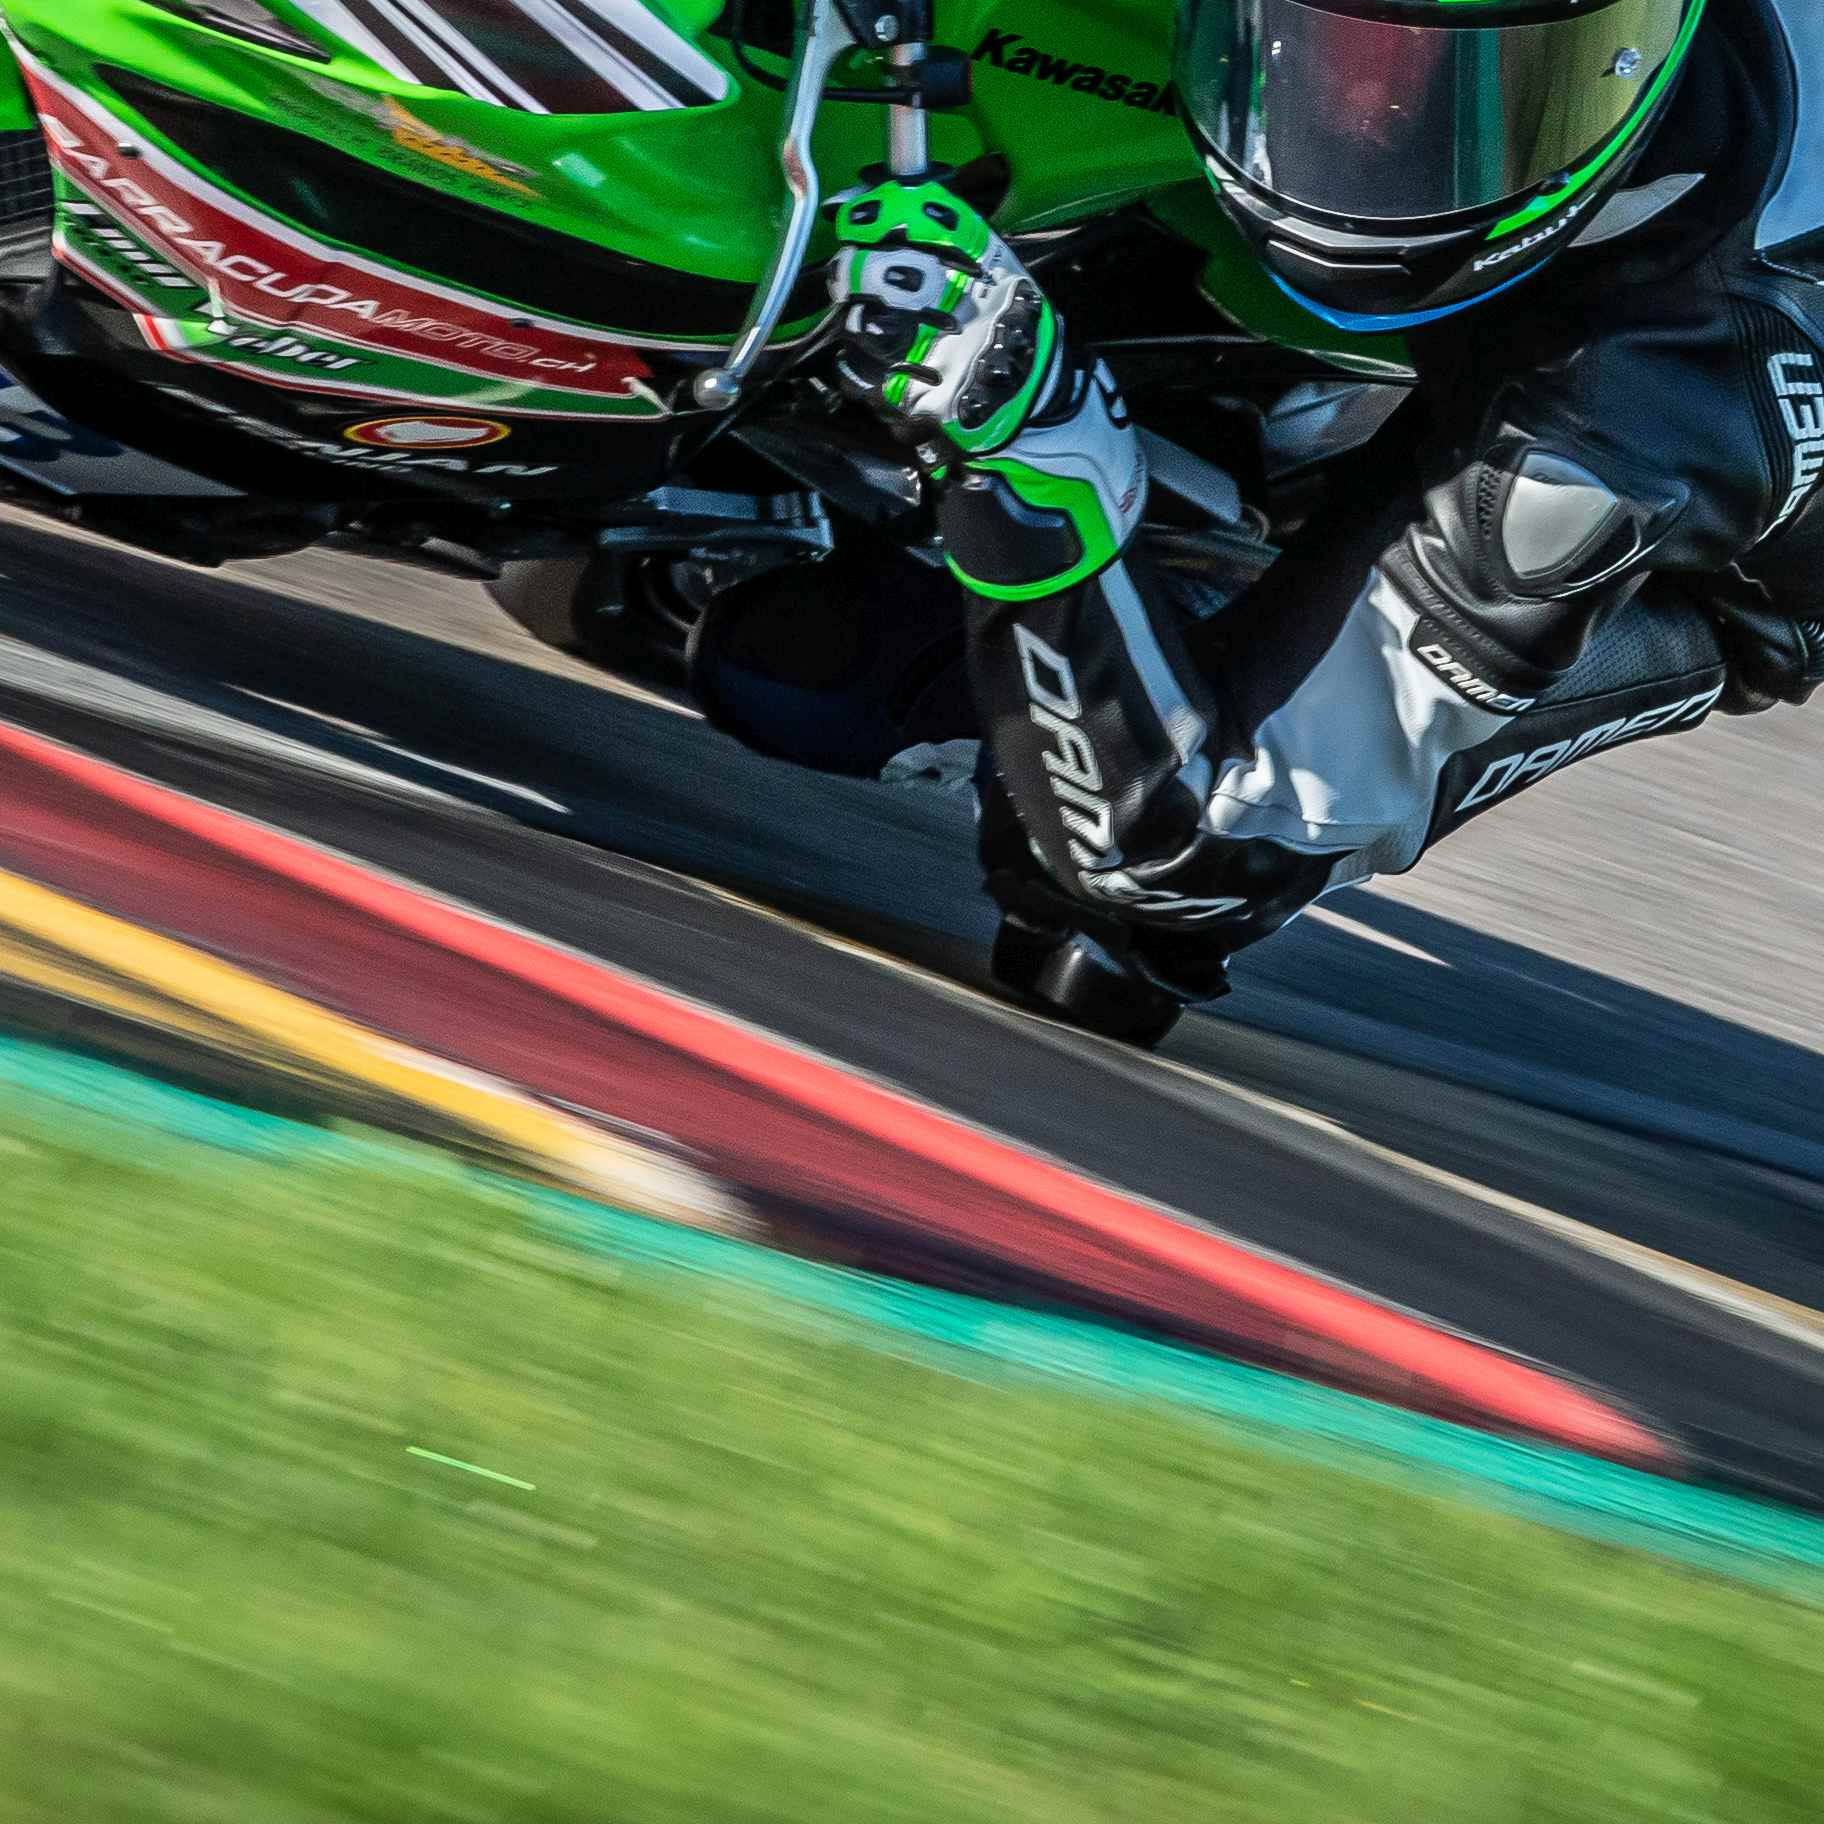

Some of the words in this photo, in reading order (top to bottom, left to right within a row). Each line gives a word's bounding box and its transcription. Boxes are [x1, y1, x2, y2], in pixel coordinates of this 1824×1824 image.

[972, 29, 1177, 115] Kawasak
[1473, 202, 1587, 272] Kabut
[1417, 643, 1534, 713] DAMEN
[1457, 684, 1722, 811] DAMEN
